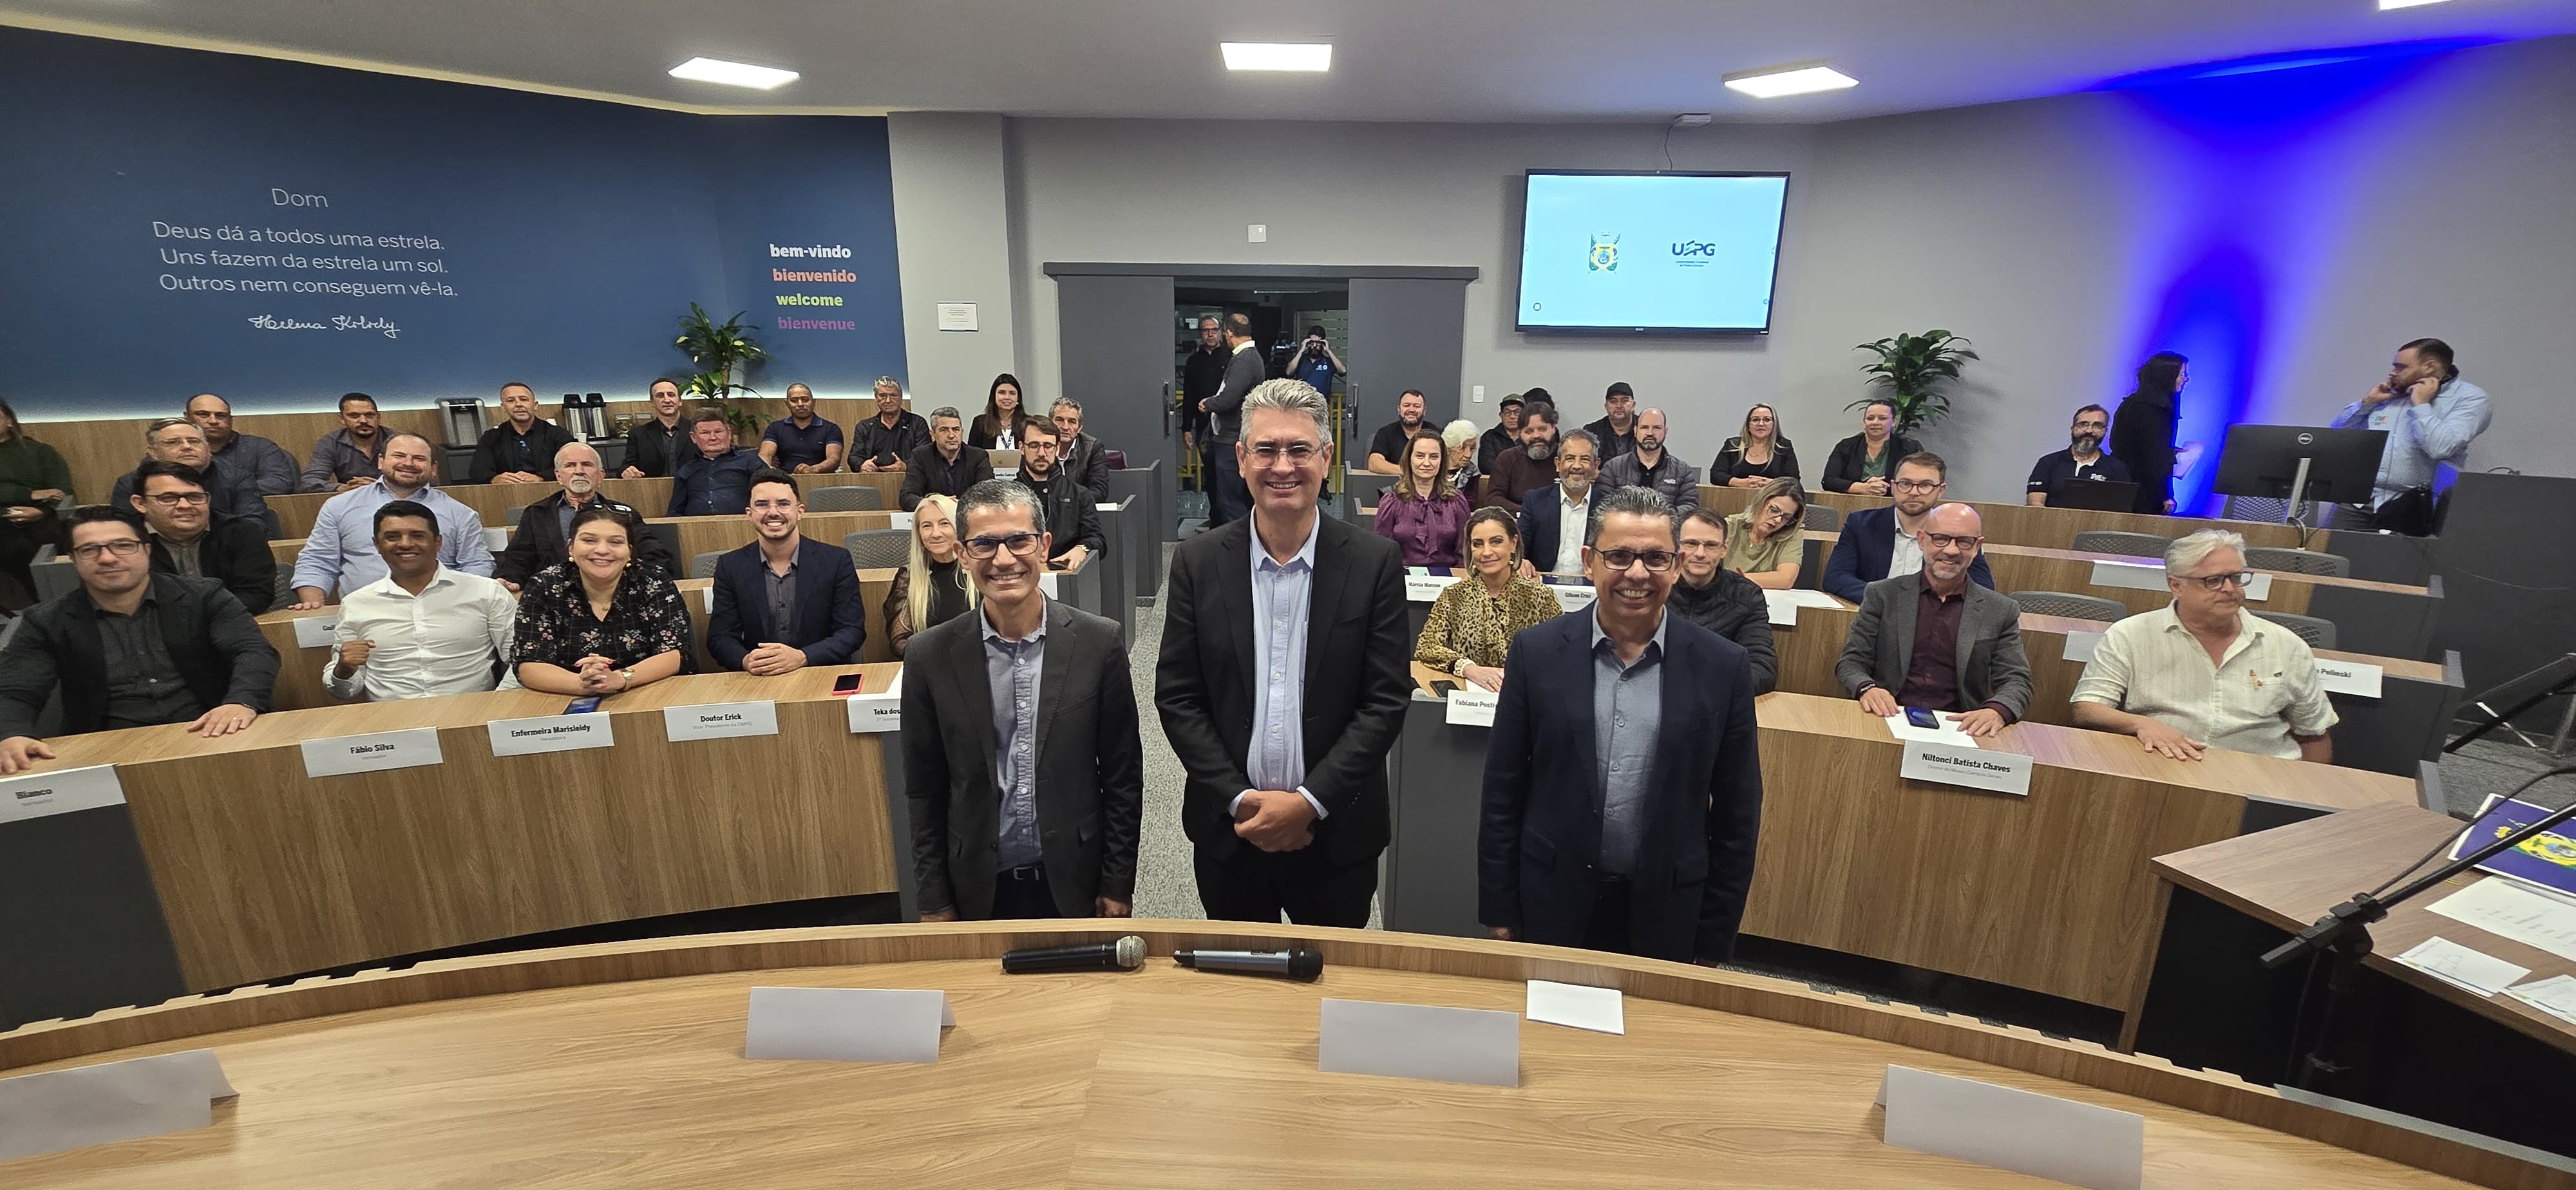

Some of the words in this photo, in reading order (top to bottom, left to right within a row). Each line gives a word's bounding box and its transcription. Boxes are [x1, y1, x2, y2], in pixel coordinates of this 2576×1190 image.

[271, 188, 329, 208] Dom
[153, 221, 212, 240] Deus
[216, 225, 245, 241] dá
[249, 230, 261, 241] a
[265, 228, 325, 244] todos
[329, 234, 374, 247] uma
[378, 235, 445, 250] estrela.
[770, 243, 851, 258] bem-vindo
[160, 248, 206, 265] Uns
[210, 250, 277, 267] fazem
[282, 253, 308, 269] da
[312, 256, 379, 270] estrela
[382, 260, 413, 272] um
[418, 259, 449, 273] sol.
[773, 269, 857, 283] bienvenido
[160, 274, 236, 291] Outros
[241, 279, 289, 292] nem
[292, 281, 406, 297] conseguem
[410, 281, 459, 296] vê-la.
[775, 293, 844, 307] welcome
[248, 314, 327, 330] Helena
[777, 316, 856, 330] bienvenue
[1455, 699, 1478, 707] Fabiana
[511, 727, 552, 737] Enfermeira
[553, 724, 591, 733] Marisleidy
[350, 745, 373, 754] Fábio
[374, 743, 395, 752] Silva
[1922, 753, 1952, 764] Niltonci
[1953, 757, 1982, 769] Batista
[1983, 762, 2011, 773] Chaves
